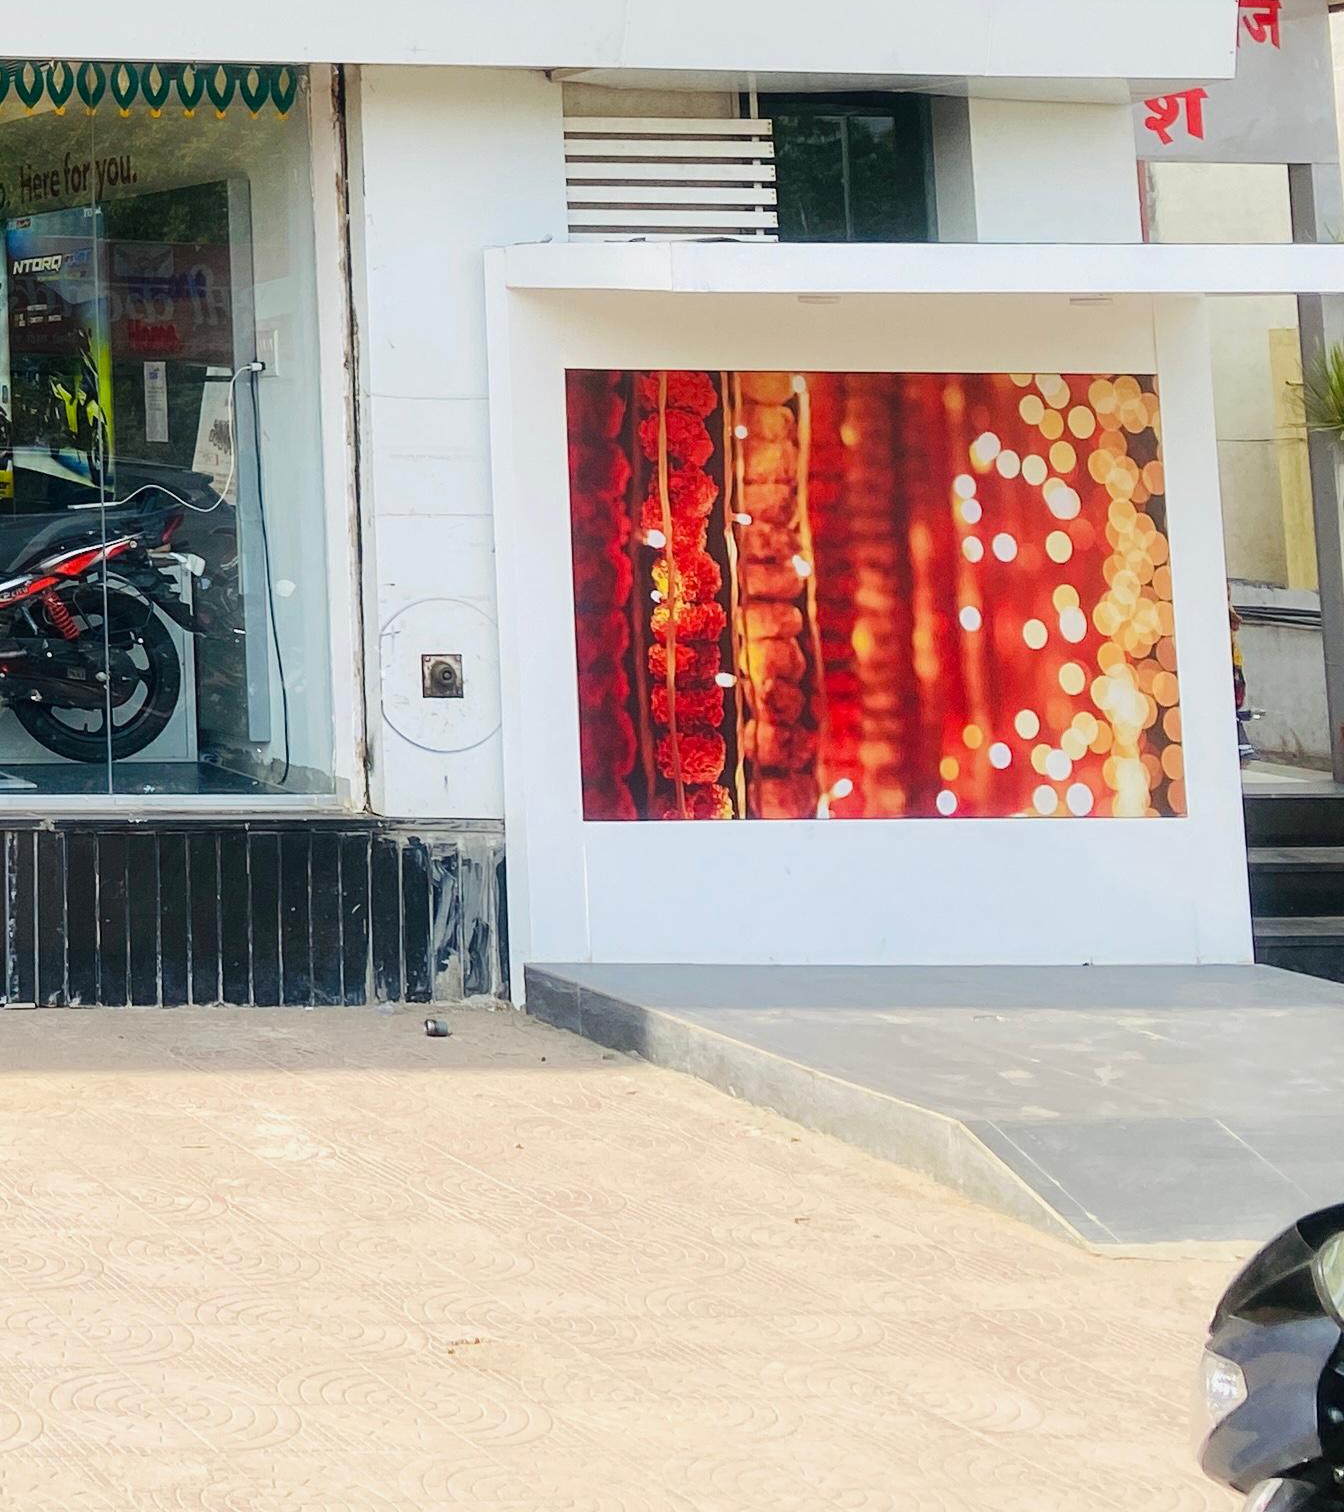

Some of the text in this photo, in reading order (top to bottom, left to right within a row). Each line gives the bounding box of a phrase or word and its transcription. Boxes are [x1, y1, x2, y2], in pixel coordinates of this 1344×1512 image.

[20, 163, 60, 204] Here
[64, 151, 91, 194] for
[95, 154, 138, 201] you.
[12, 254, 62, 275] NTORQ
